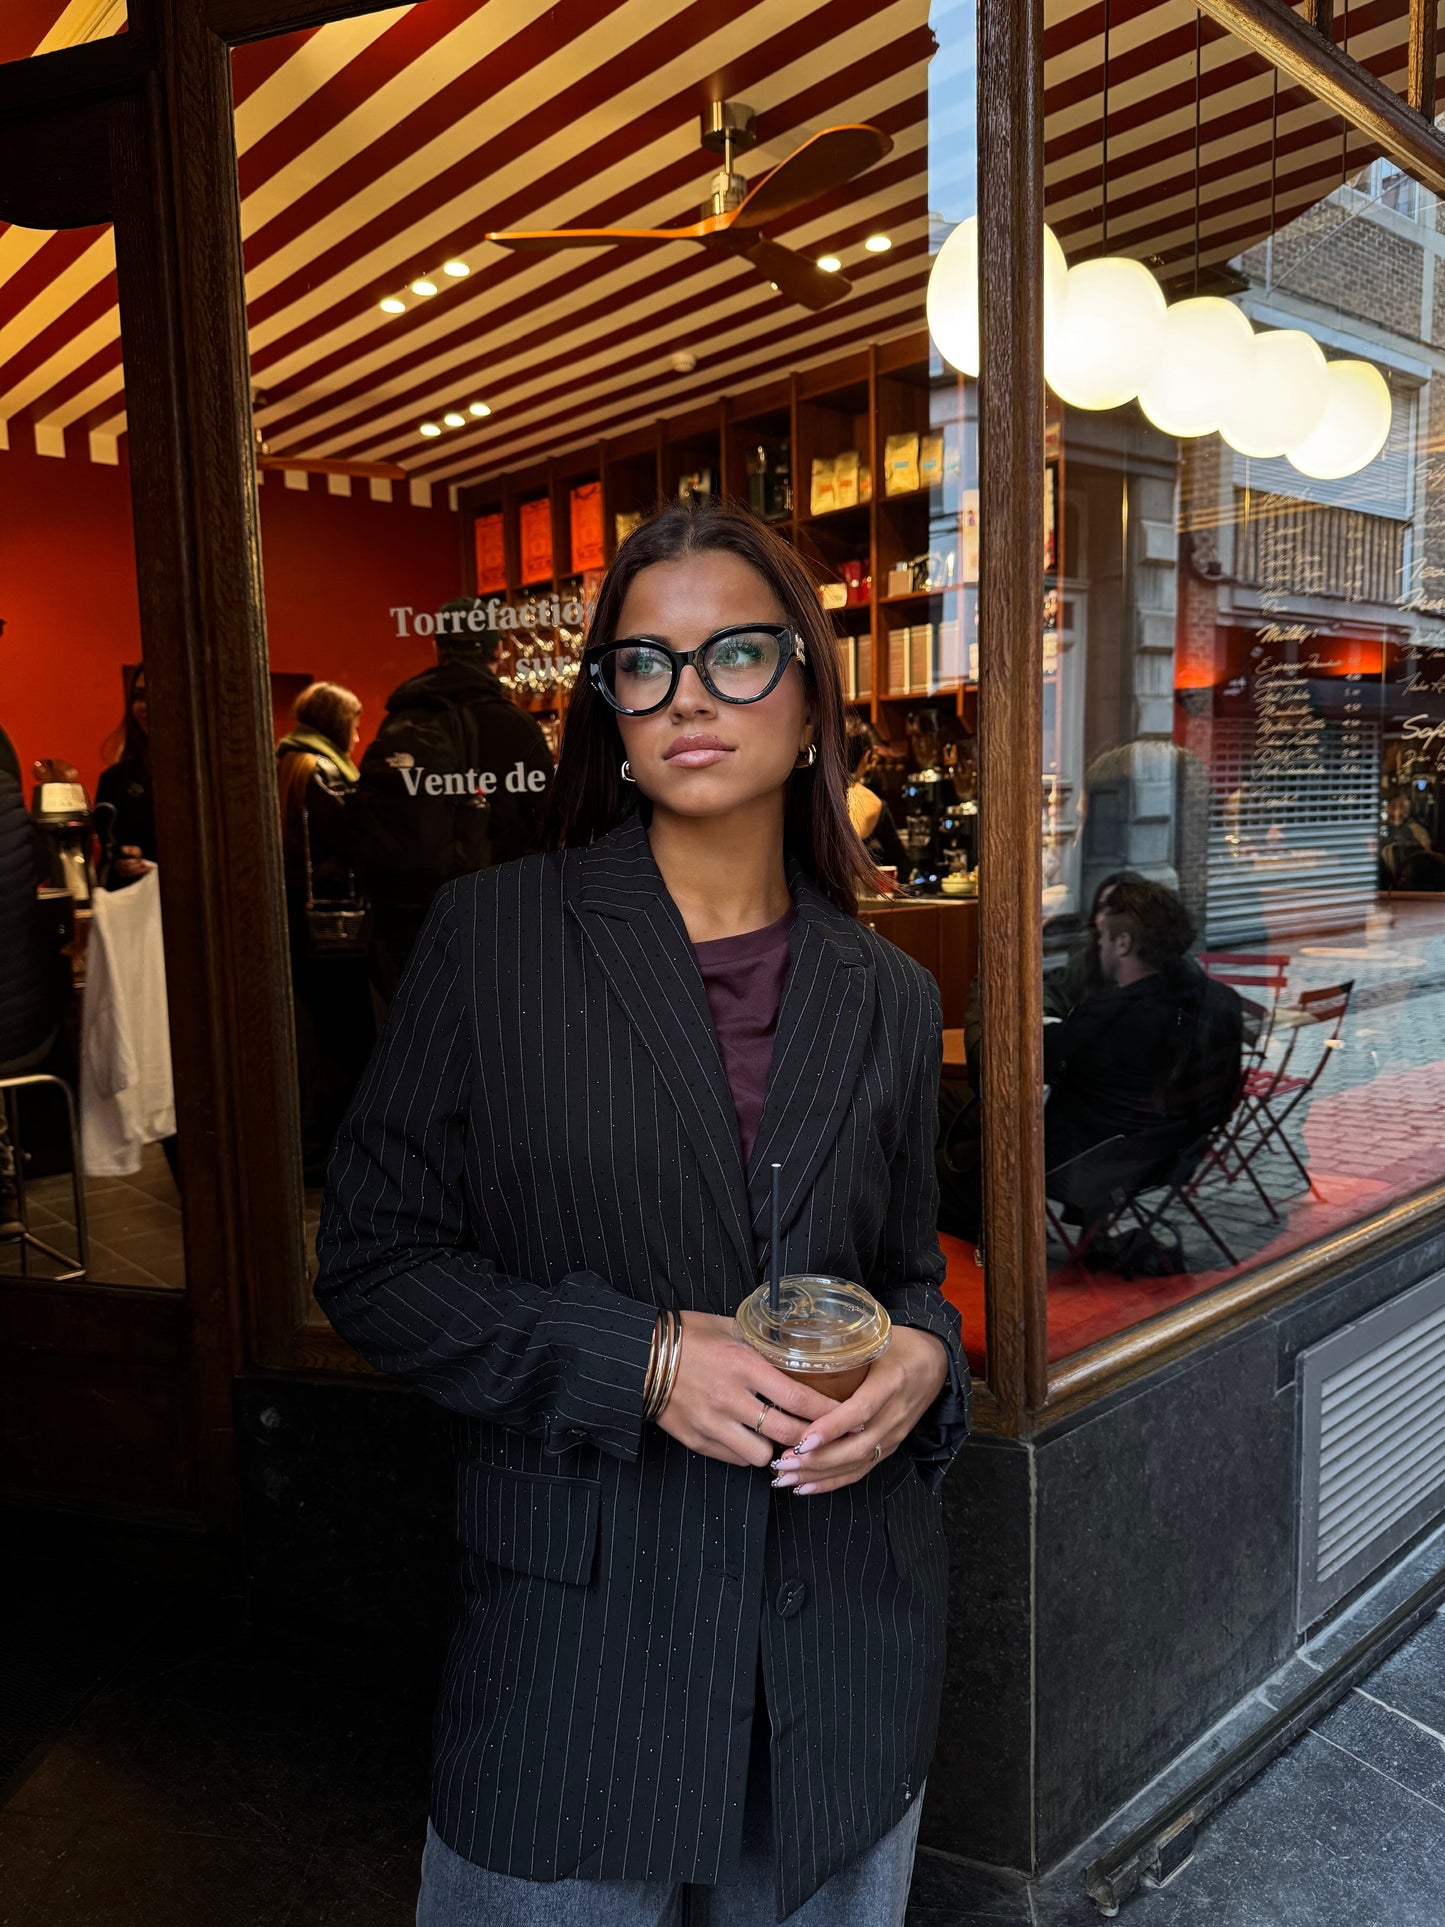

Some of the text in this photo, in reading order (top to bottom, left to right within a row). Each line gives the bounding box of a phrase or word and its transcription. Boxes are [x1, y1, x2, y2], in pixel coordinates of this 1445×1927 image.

[515, 654, 571, 682] sur
[398, 761, 546, 797] Vente de
